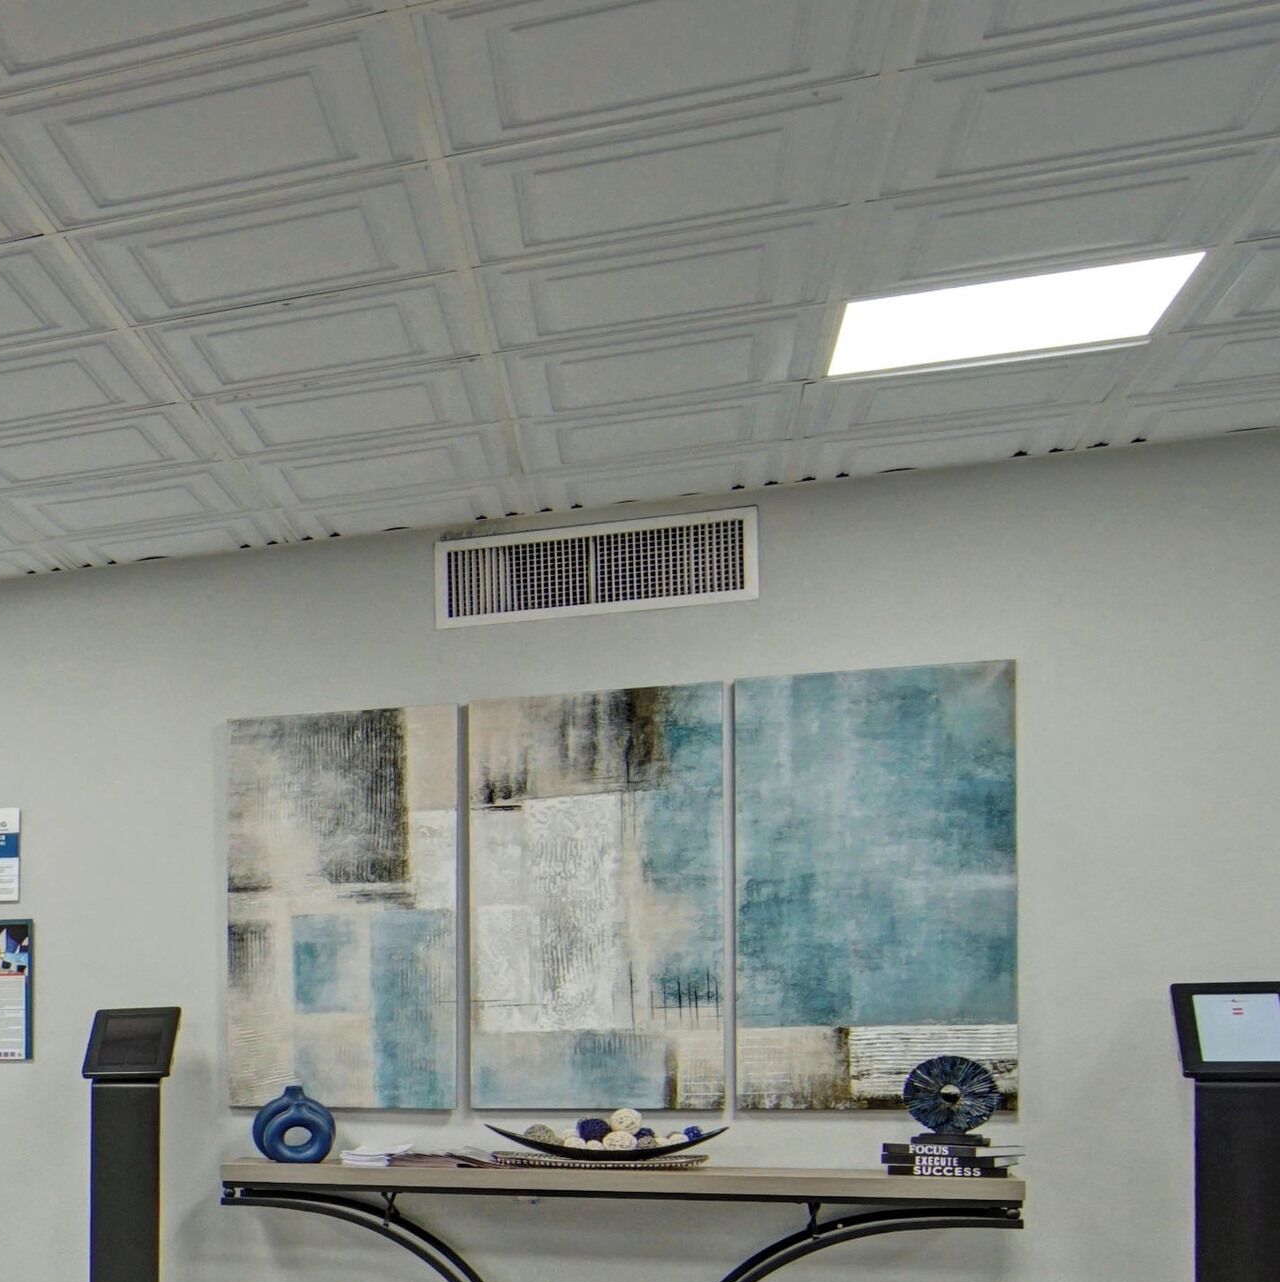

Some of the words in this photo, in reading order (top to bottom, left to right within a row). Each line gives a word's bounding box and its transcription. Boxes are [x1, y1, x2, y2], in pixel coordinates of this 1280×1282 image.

[908, 1144, 949, 1155] FOCUS
[915, 1156, 959, 1167] EXECUTE
[913, 1166, 981, 1177] SUCCESS
